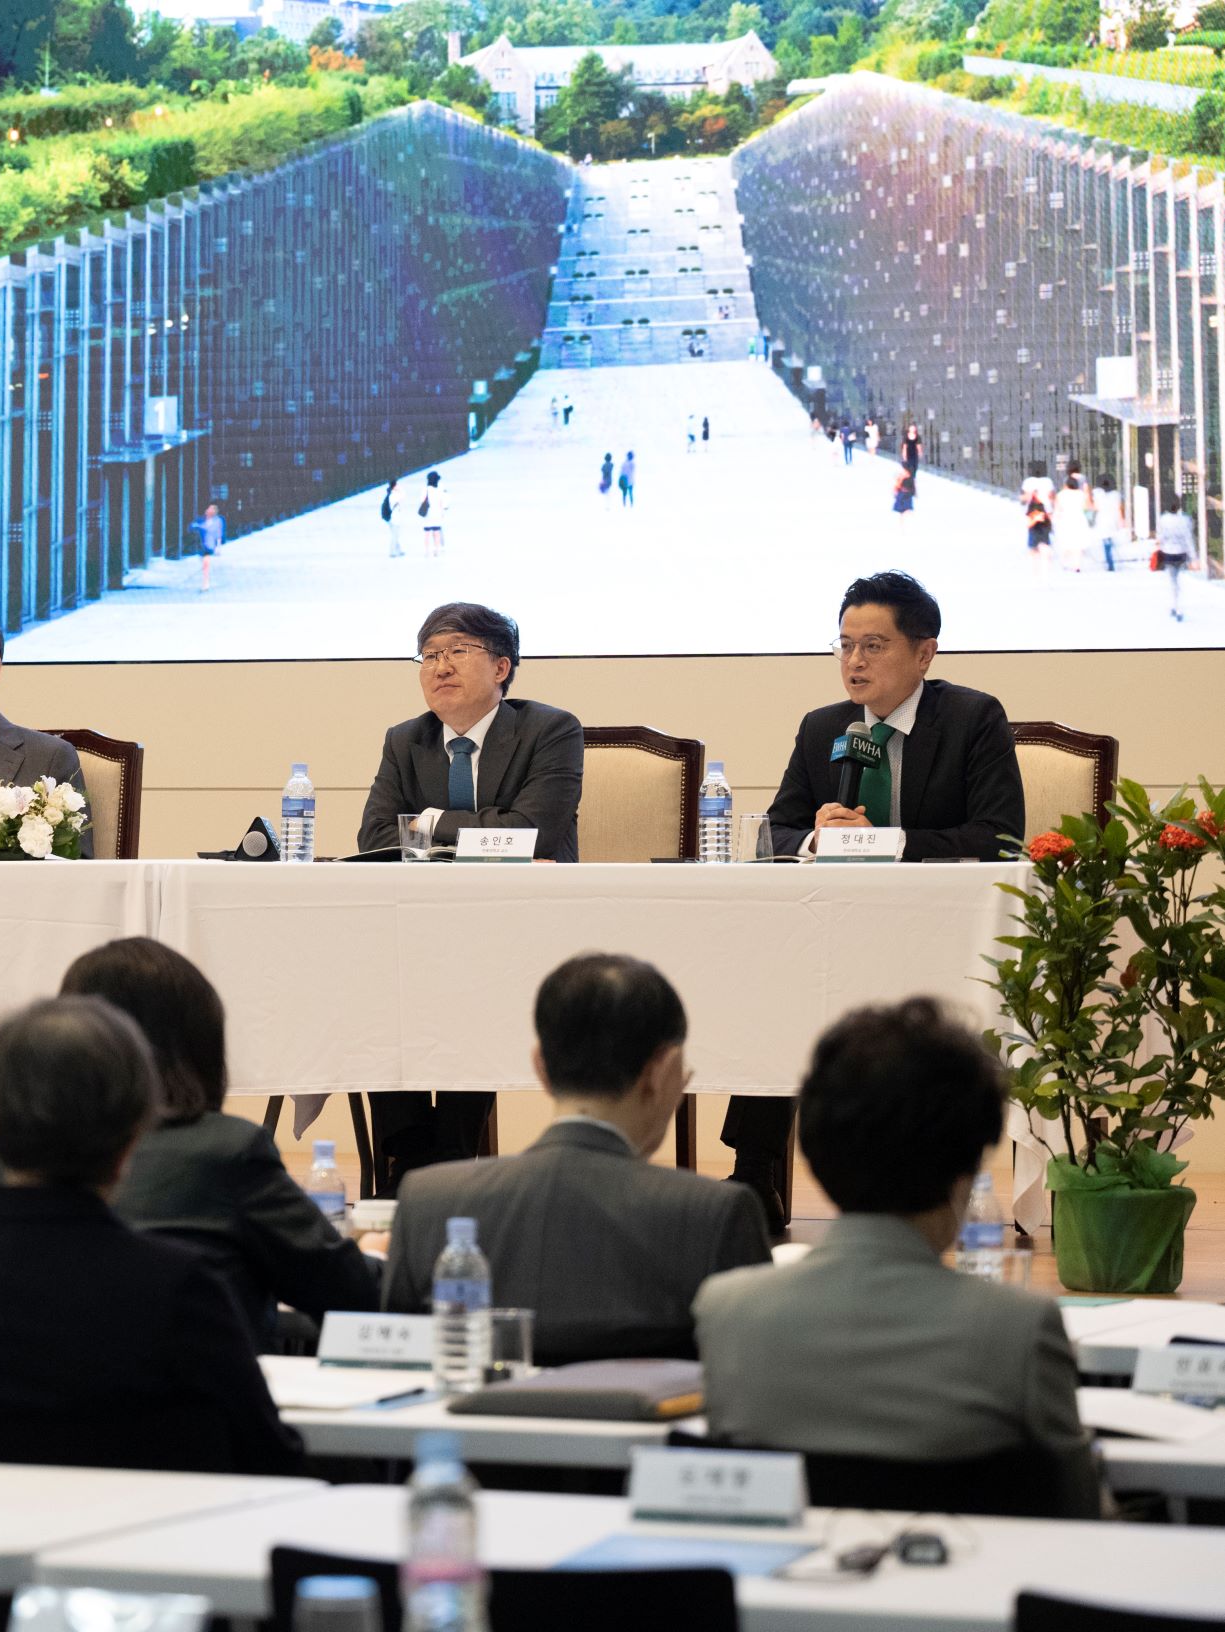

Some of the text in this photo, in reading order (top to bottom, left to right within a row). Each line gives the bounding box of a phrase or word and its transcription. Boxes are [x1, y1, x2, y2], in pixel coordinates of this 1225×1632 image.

[154, 401, 164, 431] 1
[852, 737, 881, 758] EWHA
[480, 836, 513, 846] 송인호
[841, 834, 876, 844] 정대진
